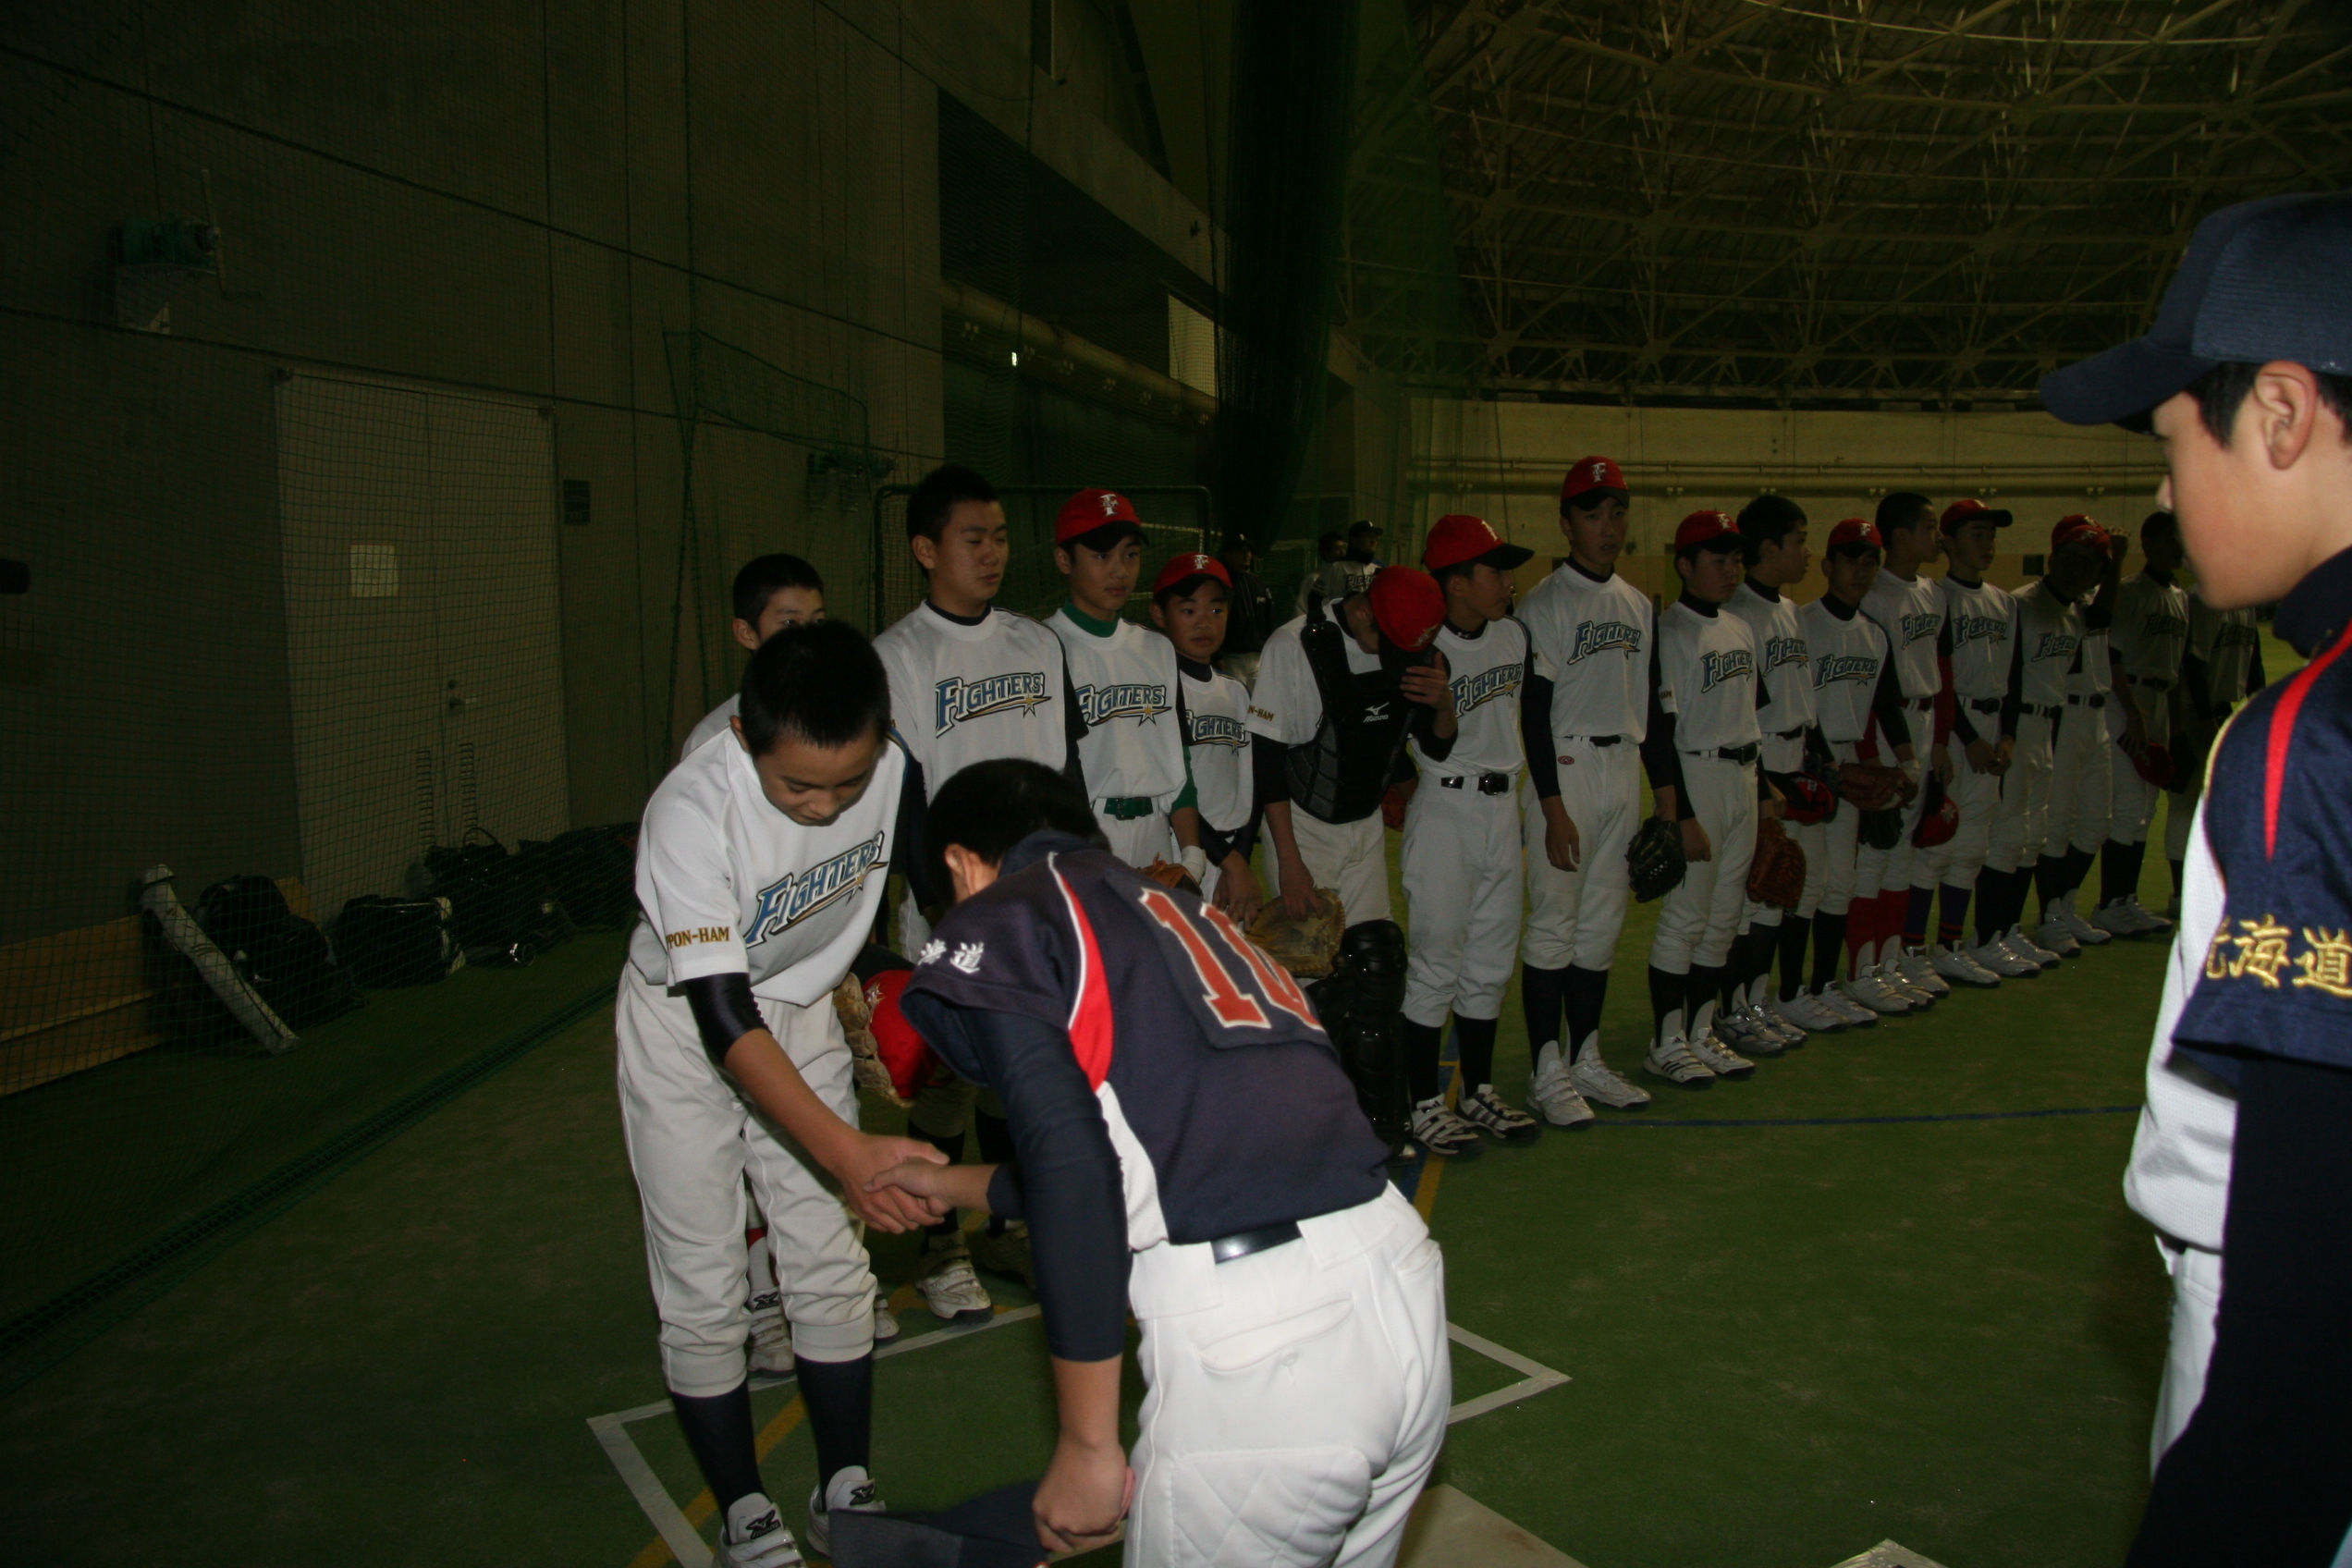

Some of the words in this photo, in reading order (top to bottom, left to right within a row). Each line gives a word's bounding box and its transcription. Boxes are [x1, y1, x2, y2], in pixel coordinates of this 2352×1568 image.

[934, 671, 1046, 739] FIGHTERS
[1449, 662, 1524, 719] FIGHTERS
[1186, 708, 1245, 742] IGHTERS
[742, 829, 885, 949] FIGHTERS
[1138, 886, 1327, 1030] 10
